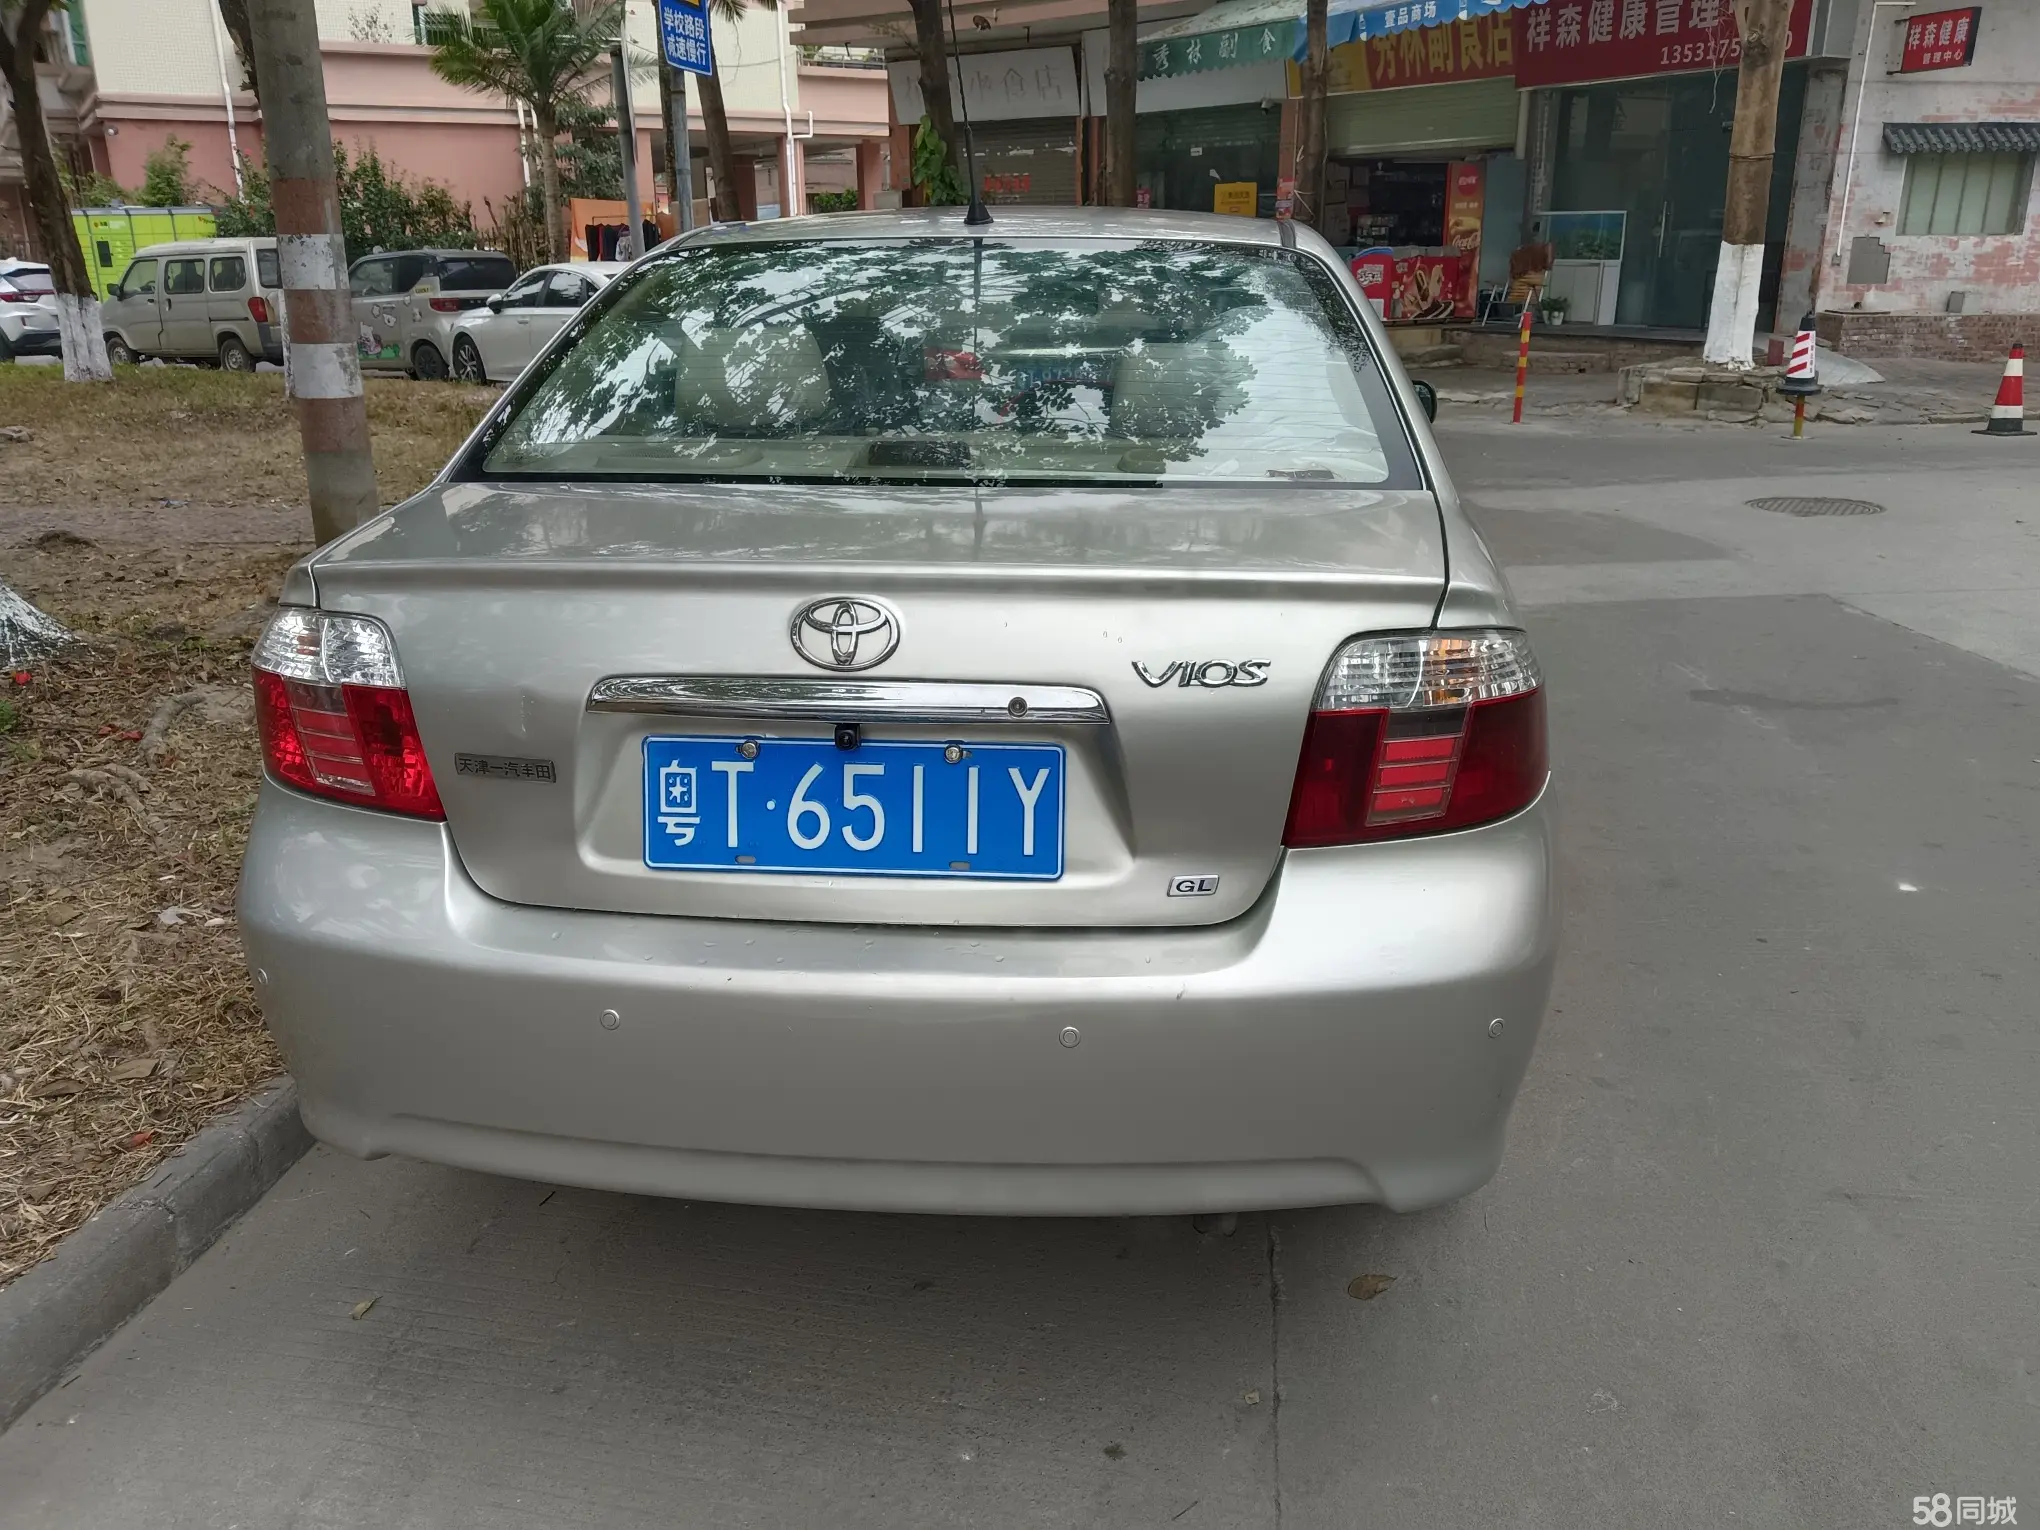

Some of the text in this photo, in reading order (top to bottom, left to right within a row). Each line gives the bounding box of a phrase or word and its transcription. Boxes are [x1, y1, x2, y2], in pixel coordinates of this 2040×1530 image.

[664, 7, 706, 41] 学校路段
[1384, 1, 1437, 28] 壹品商场
[1908, 16, 1970, 50] 祥森健康
[667, 33, 707, 65] 减速慢行
[1152, 28, 1276, 71] 秀林副食
[1922, 49, 1963, 65] 管理中心
[1131, 659, 1272, 688] VIOS
[458, 758, 551, 779] 天津一汽丰田
[1176, 880, 1212, 892] GL
